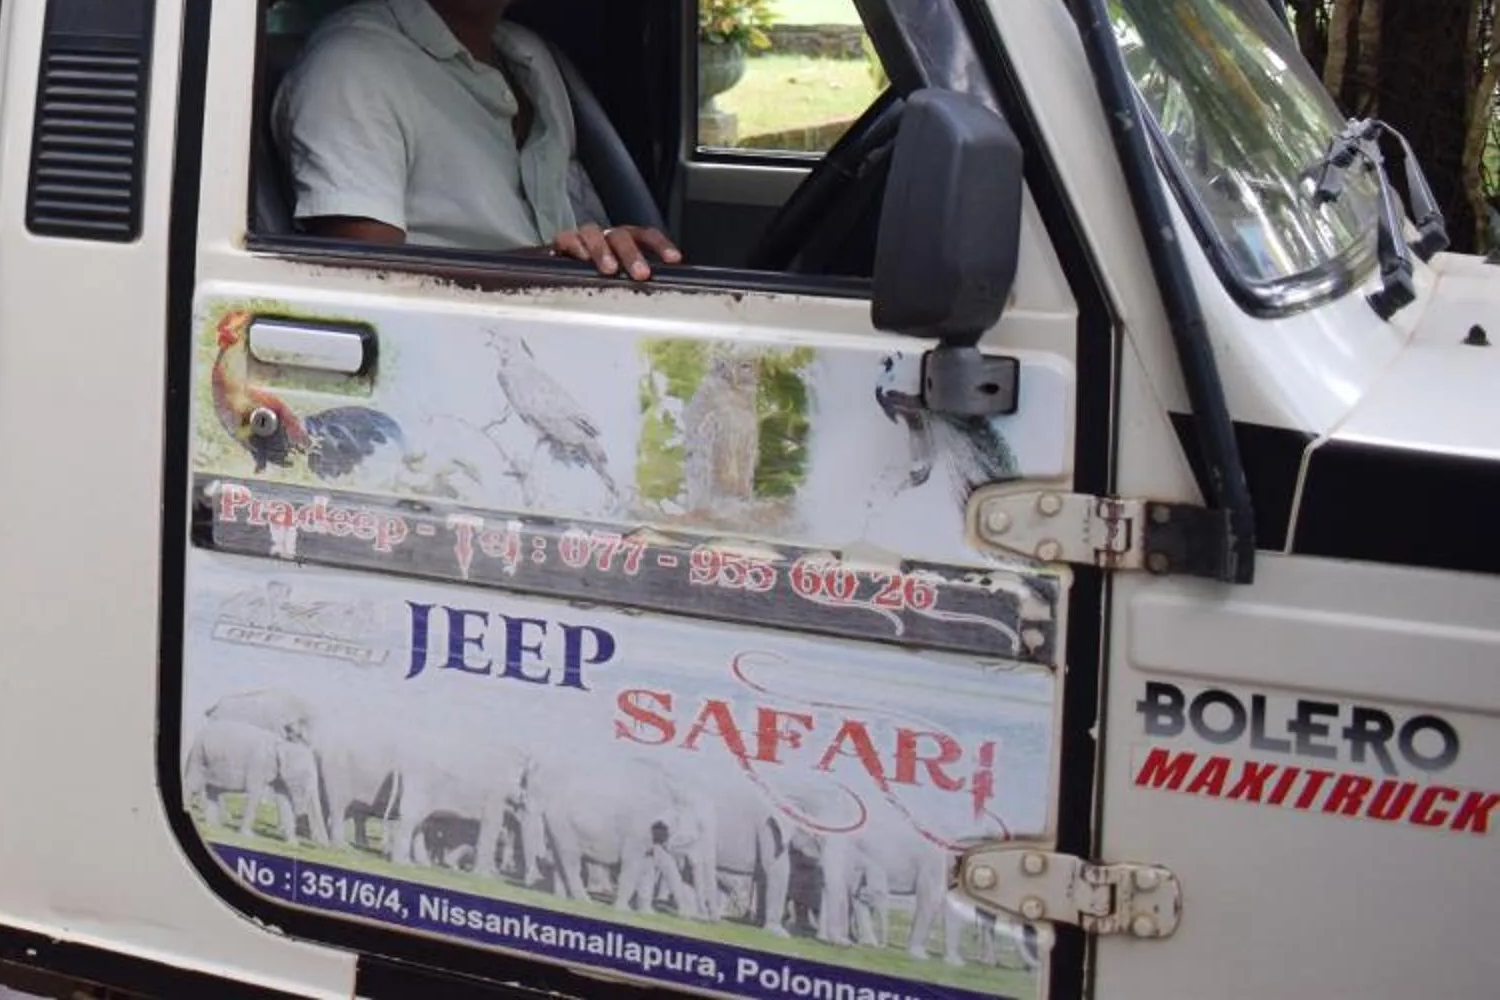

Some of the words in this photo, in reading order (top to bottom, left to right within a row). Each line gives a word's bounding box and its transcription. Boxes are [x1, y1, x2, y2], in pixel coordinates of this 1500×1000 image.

[216, 482, 410, 553] Pradeep
[558, 529, 648, 574] 077
[690, 544, 777, 592] 955
[789, 556, 859, 601] 60
[868, 571, 938, 612] 26
[405, 600, 616, 690] JEEP
[613, 688, 998, 818] SAFARI
[1136, 681, 1461, 776] BOLERO
[1135, 746, 1500, 834] MAXITRUCK
[237, 857, 275, 887] No
[301, 871, 410, 919] 351/6/4,
[419, 894, 725, 983] Nissankamallapura,
